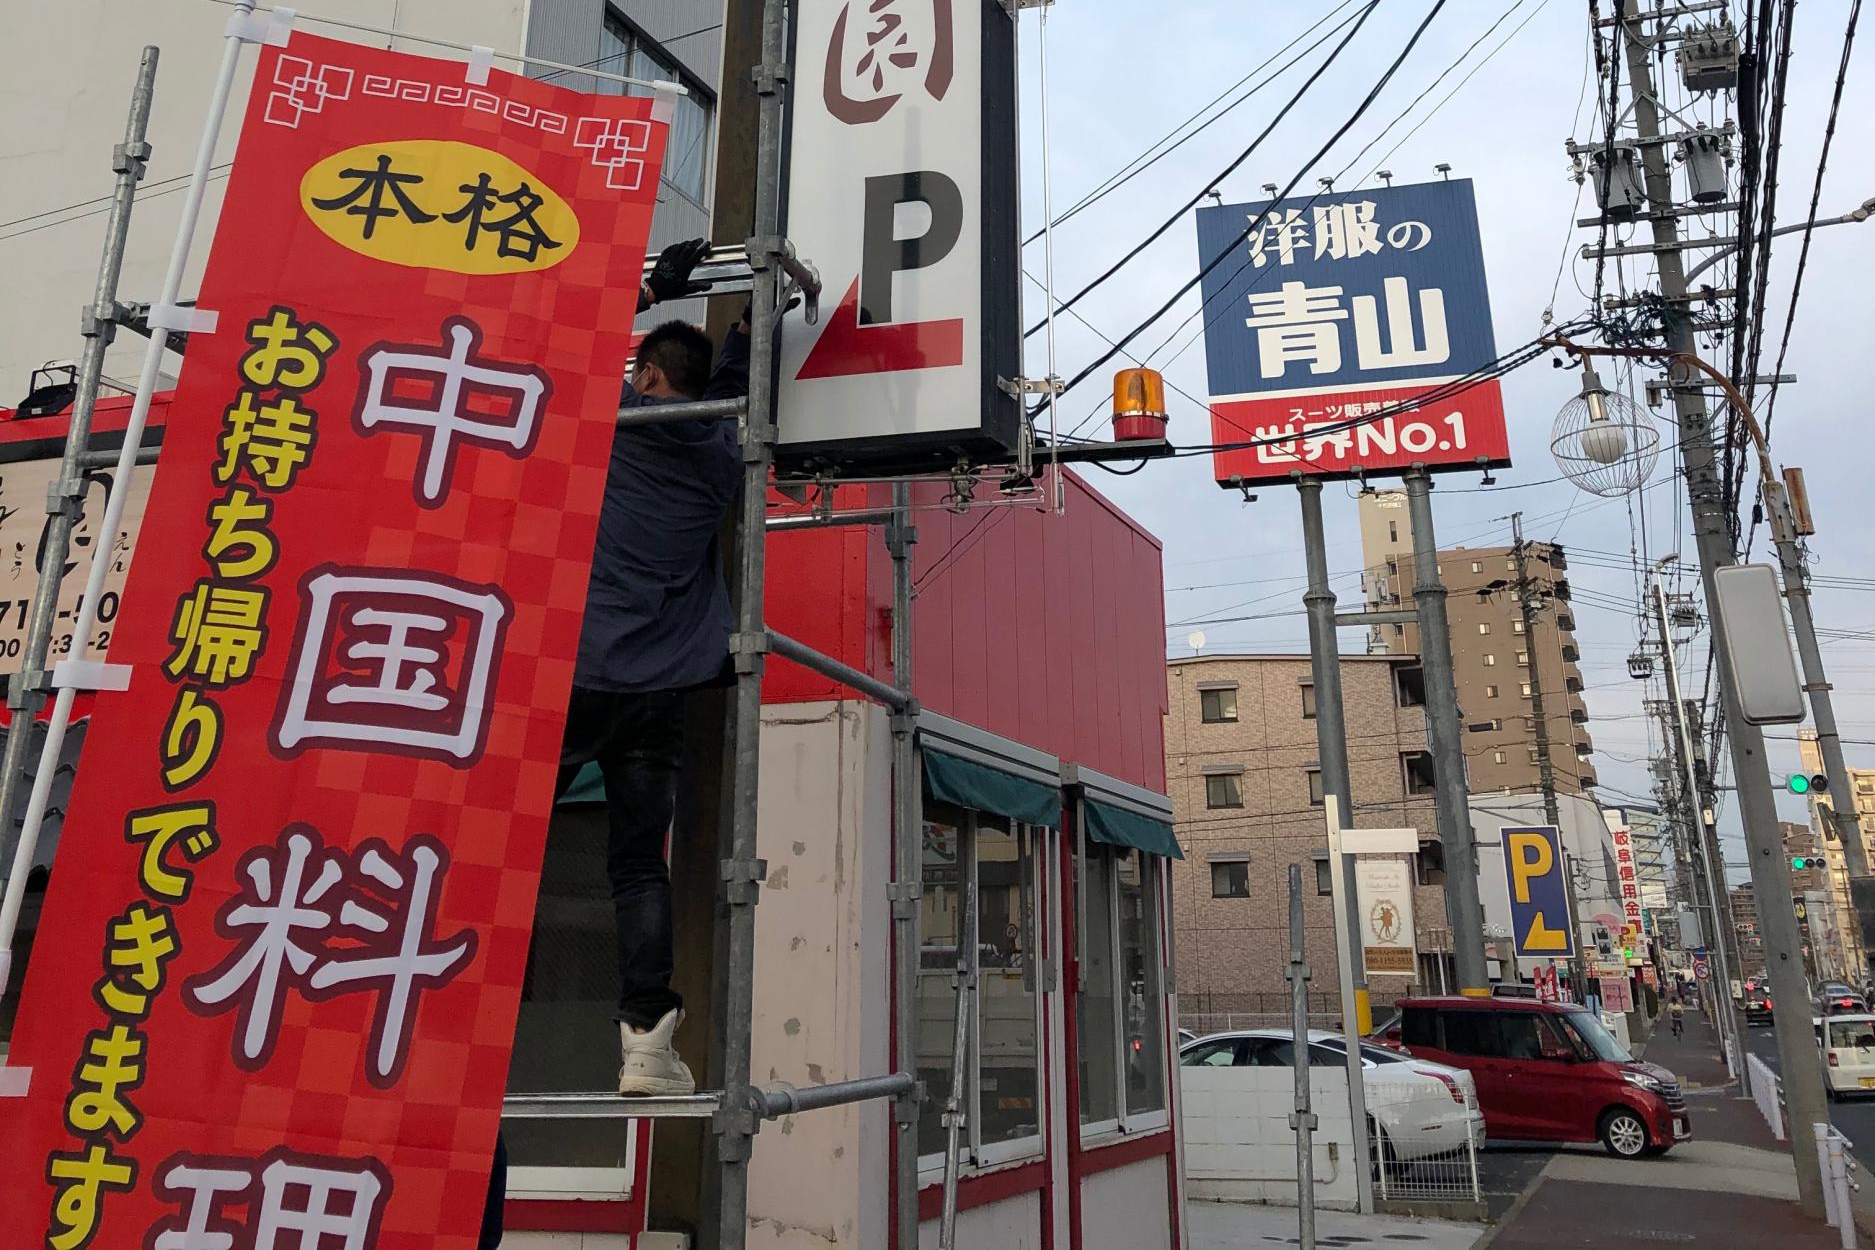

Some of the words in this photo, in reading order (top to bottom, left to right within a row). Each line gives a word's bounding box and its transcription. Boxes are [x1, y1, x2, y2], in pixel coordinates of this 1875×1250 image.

[311, 153, 563, 261] 本格
[859, 170, 964, 325] P
[1246, 200, 1432, 268] 洋服の
[1245, 276, 1451, 379] 青山
[1251, 411, 1467, 464] 世界No.1
[48, 307, 334, 1249] お持ち帰りできます
[1508, 832, 1554, 904] P
[1613, 830, 1643, 934] 岐阜信用金庫
